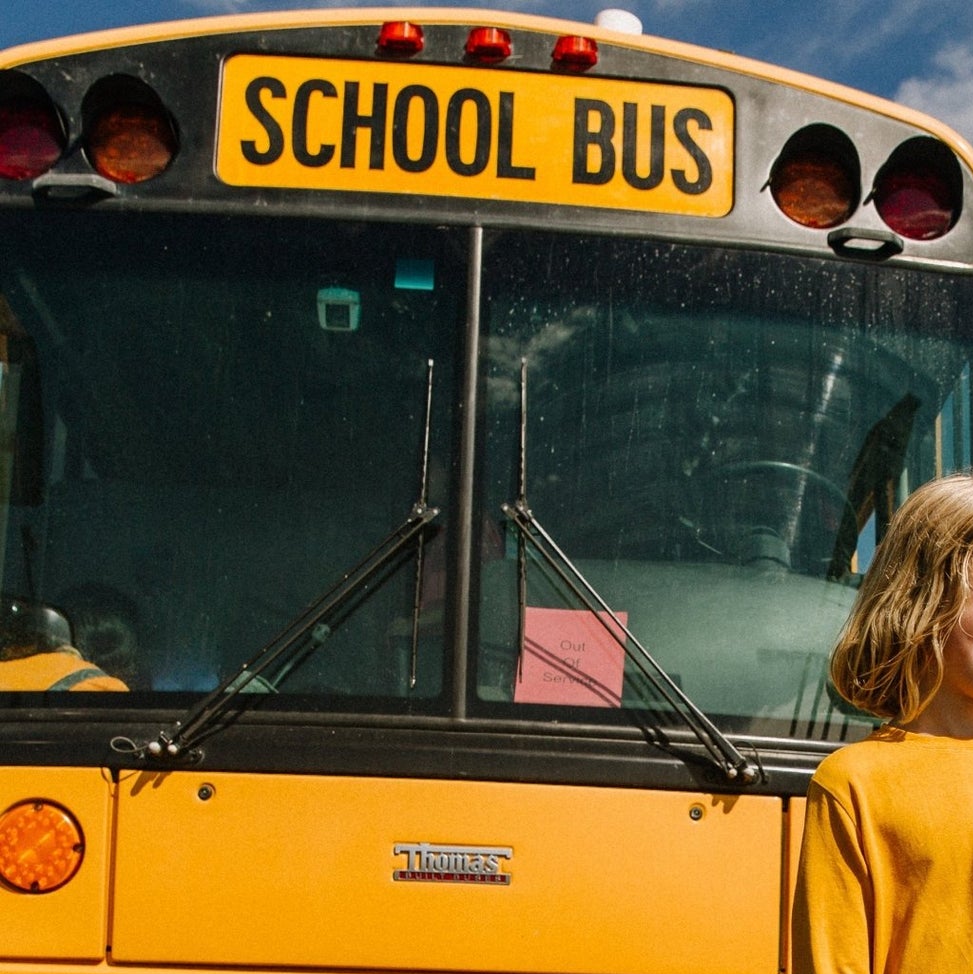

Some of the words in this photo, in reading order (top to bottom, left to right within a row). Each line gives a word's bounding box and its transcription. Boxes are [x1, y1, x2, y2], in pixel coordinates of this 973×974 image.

[240, 76, 537, 180] SCHOOL
[572, 97, 713, 195] BUS
[560, 640, 585, 652] Out
[394, 842, 513, 873] Thomas
